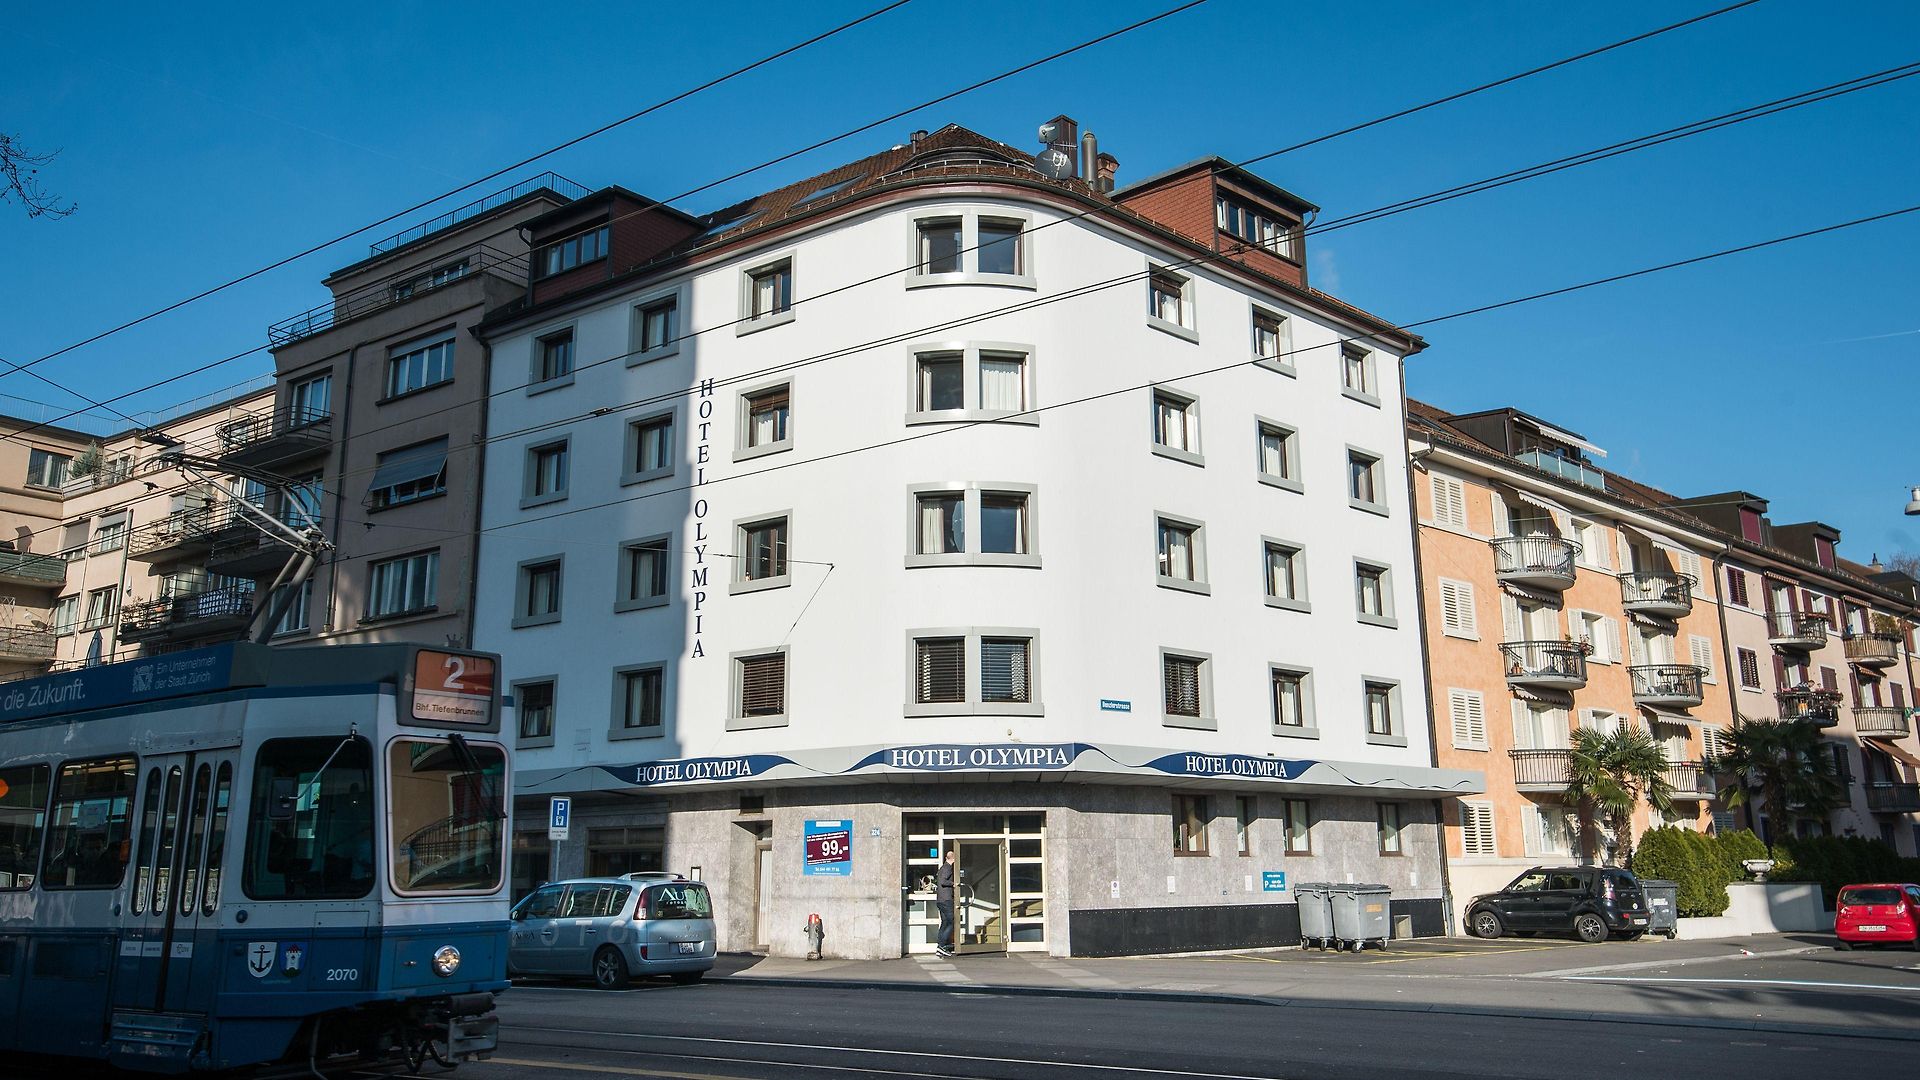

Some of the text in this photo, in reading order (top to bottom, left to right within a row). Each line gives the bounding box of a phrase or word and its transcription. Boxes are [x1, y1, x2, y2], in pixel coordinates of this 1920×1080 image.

[691, 378, 714, 658] HOTEL OLYMPIA
[156, 655, 217, 675] Ein Unternehmen
[443, 656, 465, 690] 2
[155, 670, 212, 690] der Stadt Zürich
[3, 678, 87, 712] die Zukunft.
[415, 702, 485, 717] Bhf. Tiefenbrunnen
[892, 748, 1069, 767] HOTEL OLYMPIA
[1185, 755, 1288, 778] HOTEL OLYMPIA
[636, 759, 753, 782] HOTEL OLYMPIA
[557, 802, 565, 815] P
[326, 968, 358, 982] 2070
